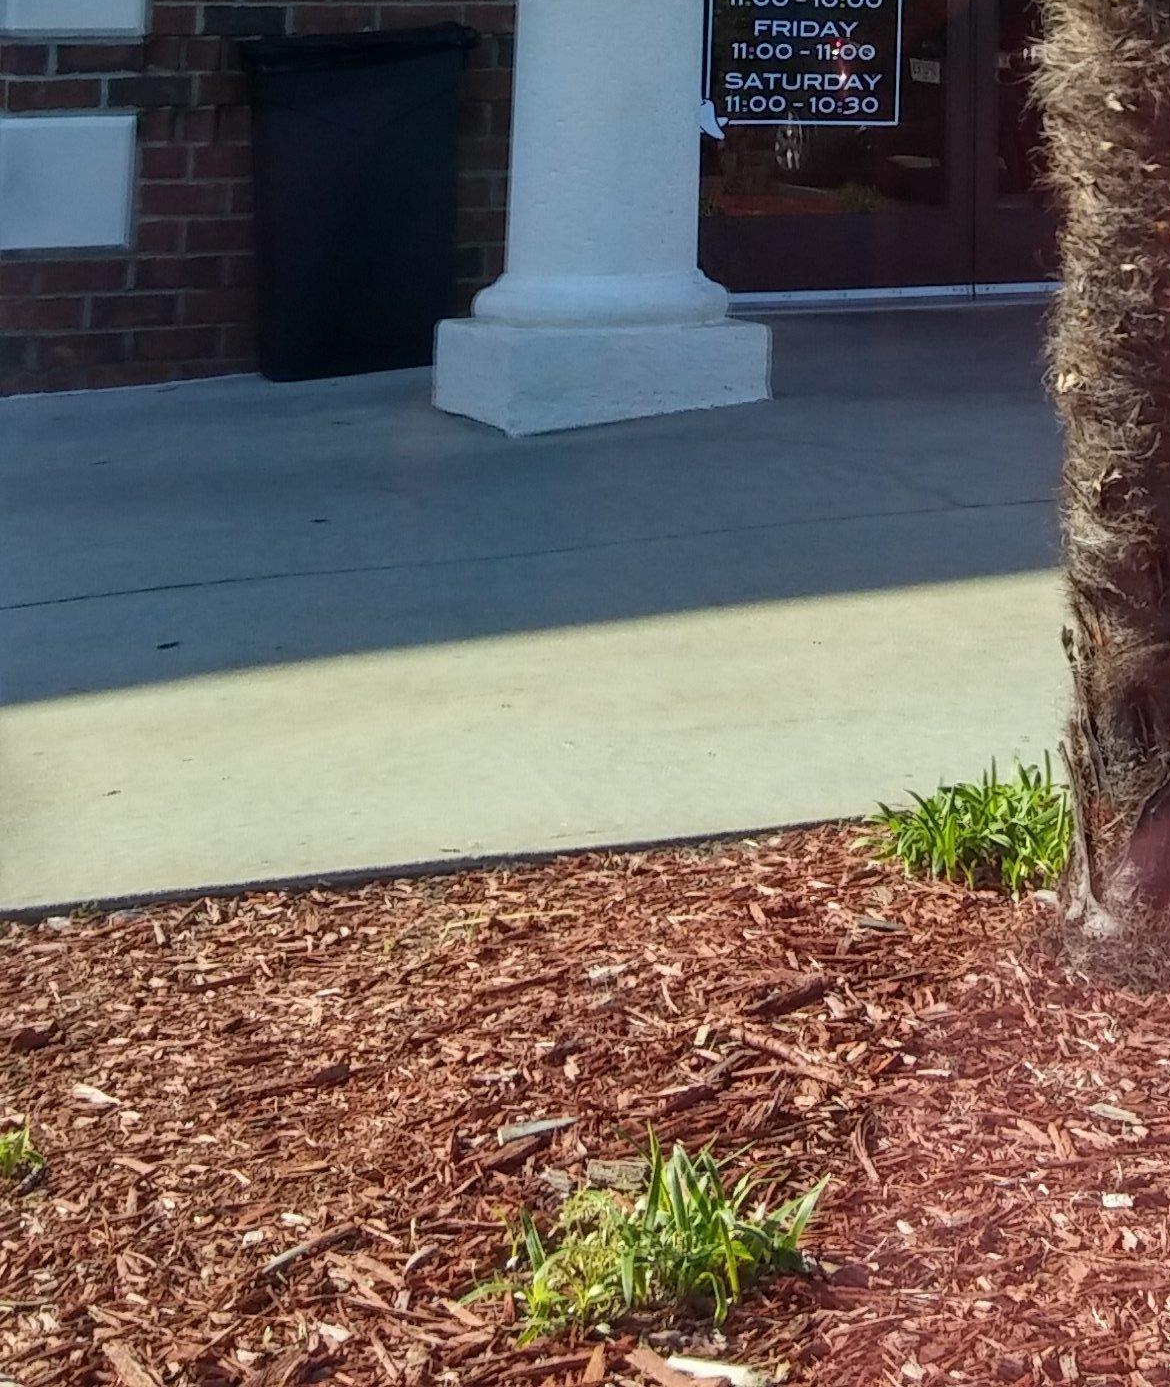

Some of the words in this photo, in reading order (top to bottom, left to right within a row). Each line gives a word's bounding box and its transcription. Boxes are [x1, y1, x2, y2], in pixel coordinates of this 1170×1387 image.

[754, 20, 859, 38] FRIDAY
[732, 42, 793, 60] 11:00
[816, 43, 876, 61] 11:00
[724, 72, 883, 91] SATURDAY
[725, 95, 787, 112] 11:00
[809, 96, 879, 114] 10:30
